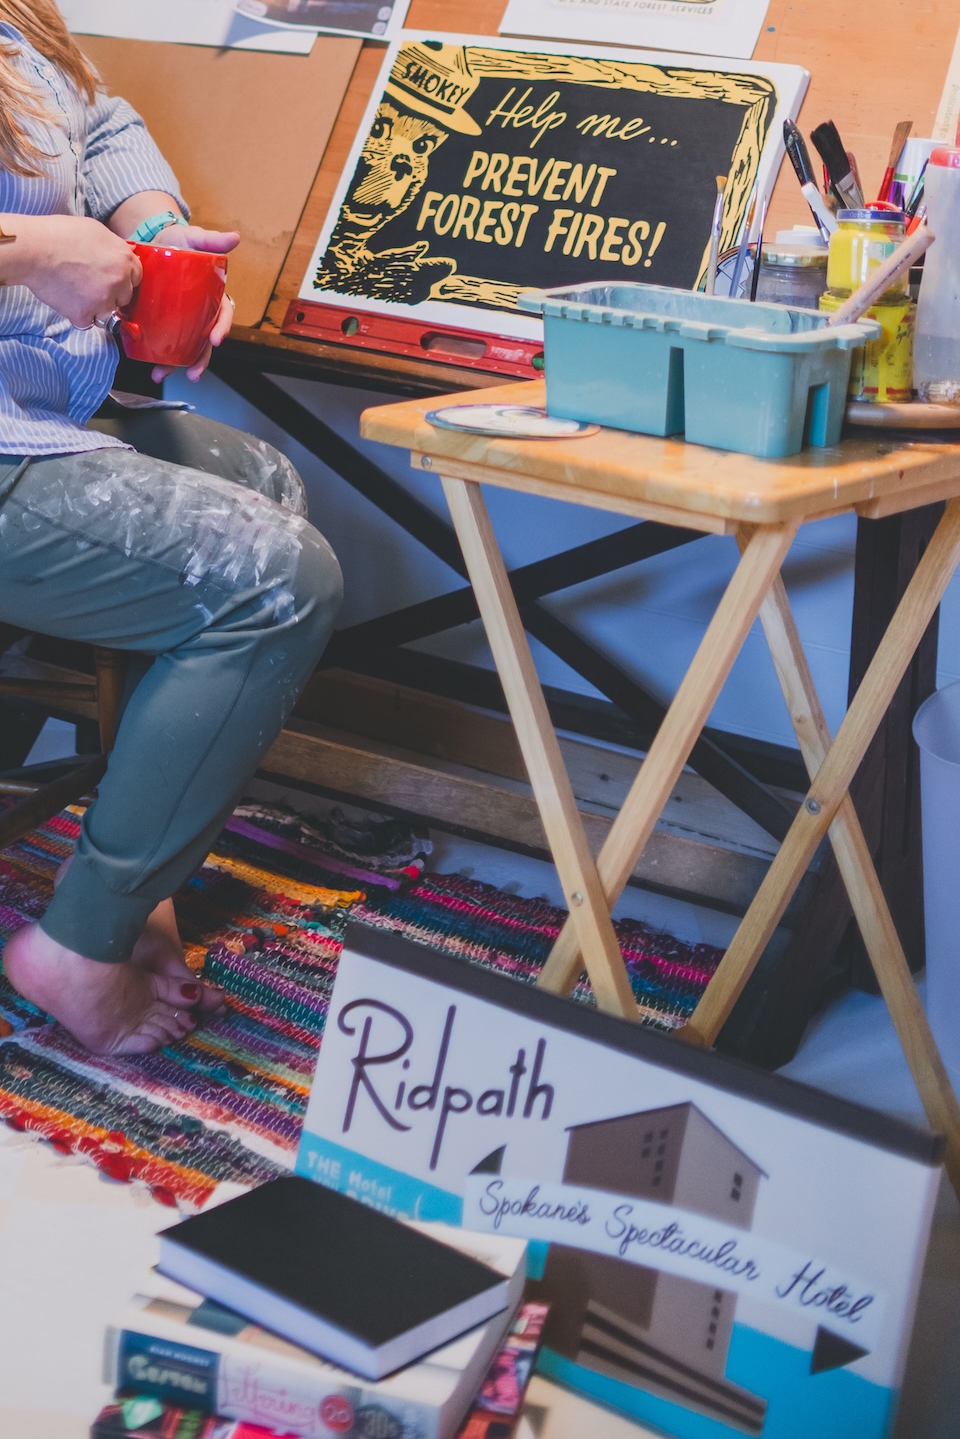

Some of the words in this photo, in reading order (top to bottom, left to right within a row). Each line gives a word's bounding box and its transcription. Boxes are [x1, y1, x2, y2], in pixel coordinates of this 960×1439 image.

[603, 0, 630, 9] STATE
[633, 0, 667, 11] FOREST
[669, 3, 713, 15] SERVICES
[401, 61, 470, 106] SMOKEY
[485, 86, 567, 149] Help
[576, 113, 679, 147] me...
[462, 150, 618, 208] PREVENT
[416, 191, 539, 249] FOREST
[543, 207, 667, 268] FIRES!
[849, 210, 873, 219] Gerber
[337, 997, 555, 1172] Ridpath
[307, 1150, 342, 1178] THE
[605, 1205, 760, 1281] Spectacular
[775, 1261, 874, 1323] Hotel
